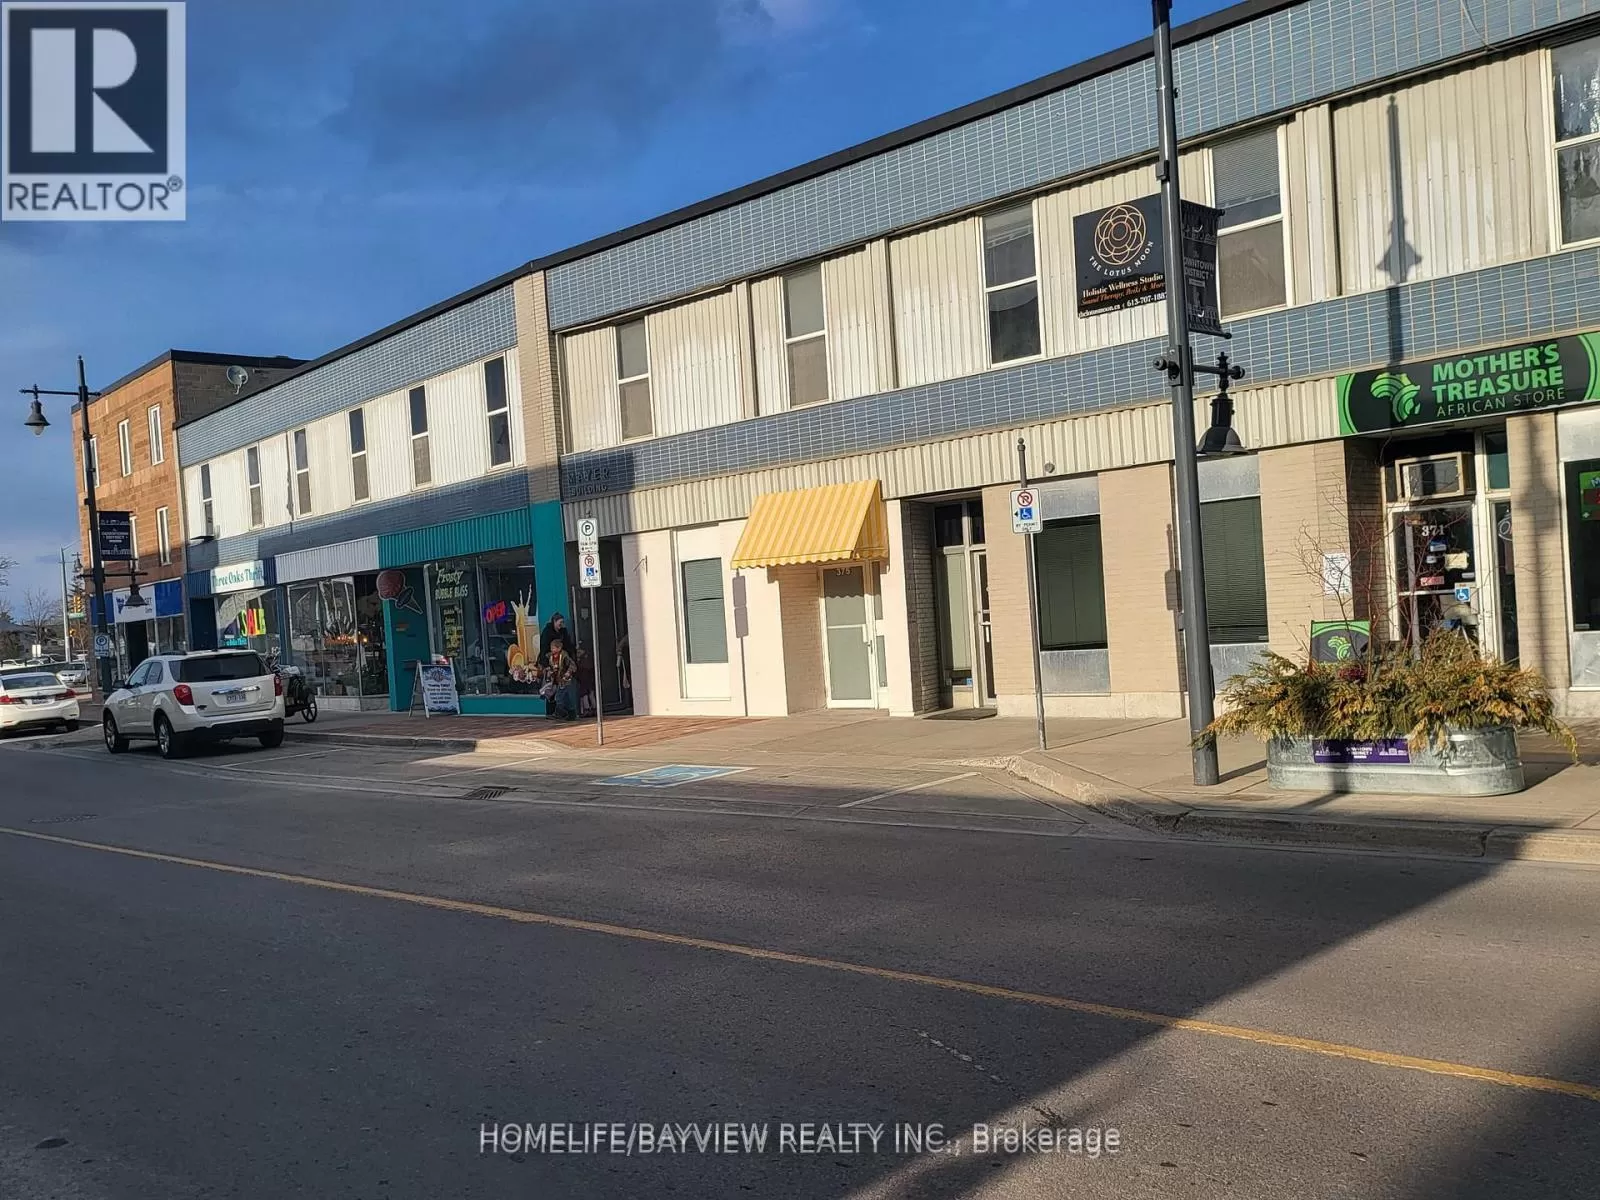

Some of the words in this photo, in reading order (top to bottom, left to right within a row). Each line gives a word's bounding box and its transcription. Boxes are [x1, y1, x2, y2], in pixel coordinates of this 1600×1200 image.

[1089, 255, 1101, 272] THE
[1103, 266, 1132, 277] LOTUS
[1134, 240, 1154, 268] MOON
[1183, 257, 1215, 271] OWNTOWN
[1083, 286, 1108, 298] Holistic
[1109, 280, 1138, 292] Wellness
[1140, 273, 1164, 284] Studio
[1433, 344, 1560, 382] MOTHER'S
[1432, 365, 1564, 404] TREASURE
[1436, 399, 1506, 418] AFRICAN
[1514, 388, 1565, 407] STORE
[1421, 525, 1445, 537] 371
[229, 571, 244, 584] Oaks
[436, 568, 463, 584] Frosty
[454, 584, 468, 598] BLISS
[240, 608, 266, 637] SALE
[486, 601, 506, 623] OPEN
